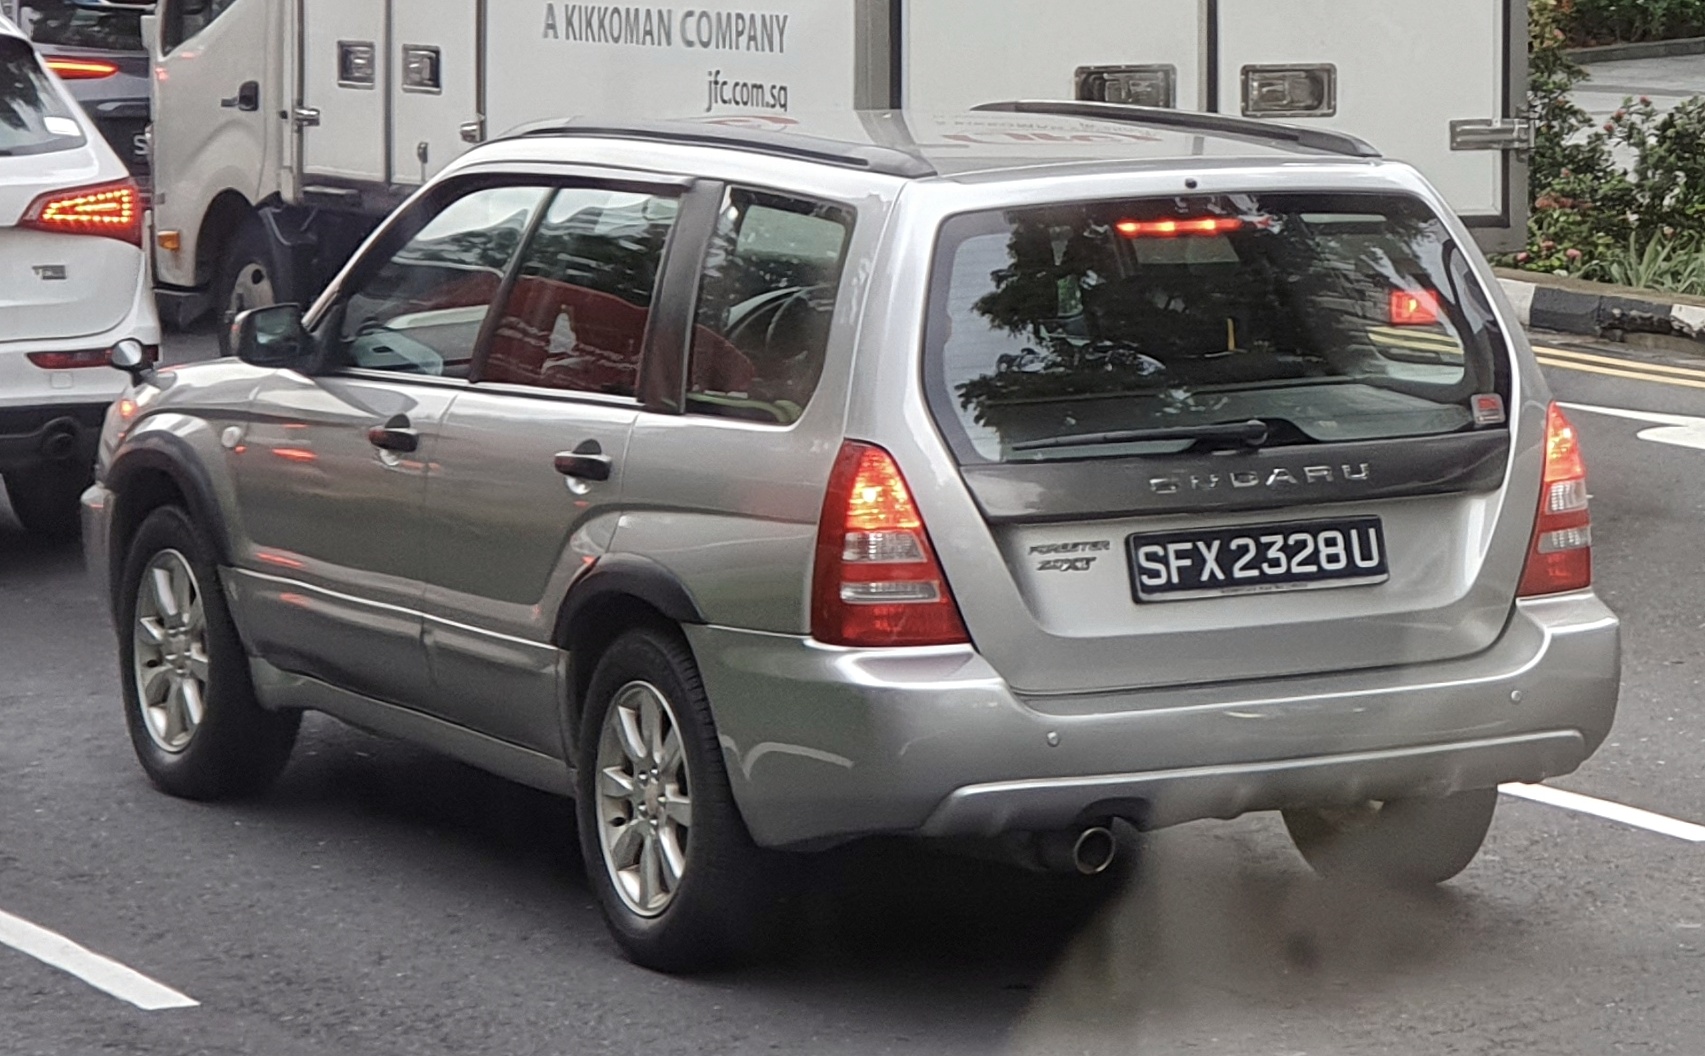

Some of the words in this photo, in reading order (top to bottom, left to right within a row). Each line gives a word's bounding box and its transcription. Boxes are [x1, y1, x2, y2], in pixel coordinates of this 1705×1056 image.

[542, 3, 559, 39] A
[564, 4, 672, 46] KIKKOMAN
[679, 10, 788, 53] COMPANY
[1149, 463, 1369, 494] SUBARU
[1138, 528, 1380, 586] SFX2328U
